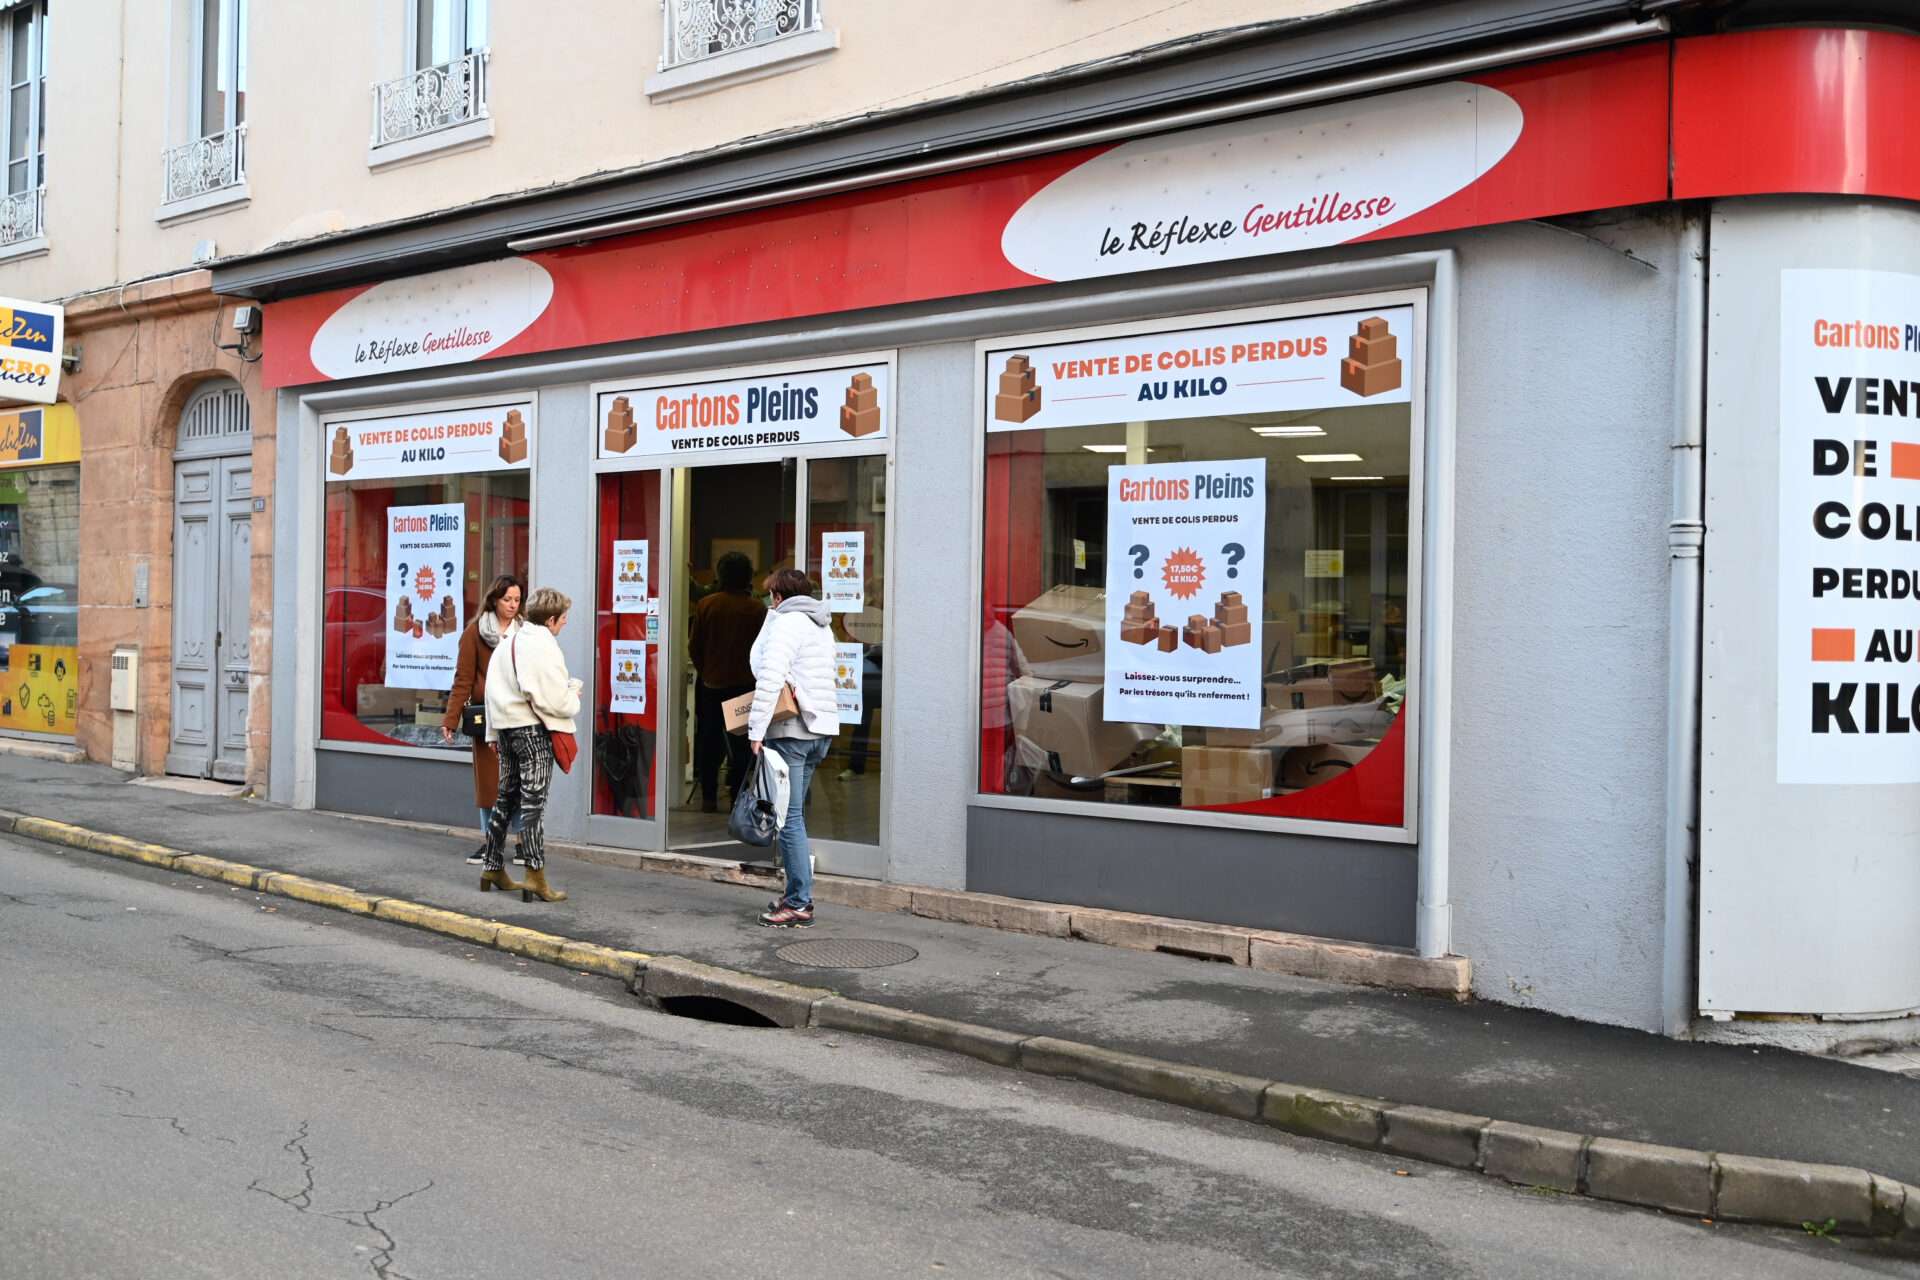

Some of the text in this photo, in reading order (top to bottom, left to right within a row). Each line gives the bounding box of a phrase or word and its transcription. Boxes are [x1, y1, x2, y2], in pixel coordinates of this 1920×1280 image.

[1100, 192, 1396, 258] le Réflexe Gentillesse
[355, 326, 493, 364] le Réflexe Gentillesse
[1814, 319, 1900, 350] Cartons
[1052, 336, 1328, 381] VENTE DE COLIS PERDUS
[1137, 376, 1228, 402] AU KILO
[655, 382, 819, 431] Cartons Pleins
[358, 420, 493, 446] VENTE DE COLIS PERDUS
[671, 430, 800, 450] VENTE DE COLIS PERDUS
[401, 446, 446, 463] AU KILO
[1813, 439, 1877, 477] DE
[1119, 472, 1254, 502] Cartons Pleins
[393, 512, 459, 533] Cartons Pleins
[1132, 514, 1239, 525] VENTE DE COLIS PERDUS
[1170, 575, 1198, 583] LE KILO
[1864, 629, 1912, 663] AU
[1125, 672, 1181, 682] Laissez-vous
[1133, 688, 1144, 696] les
[1145, 689, 1173, 697] trésors
[1198, 691, 1245, 700] renferment
